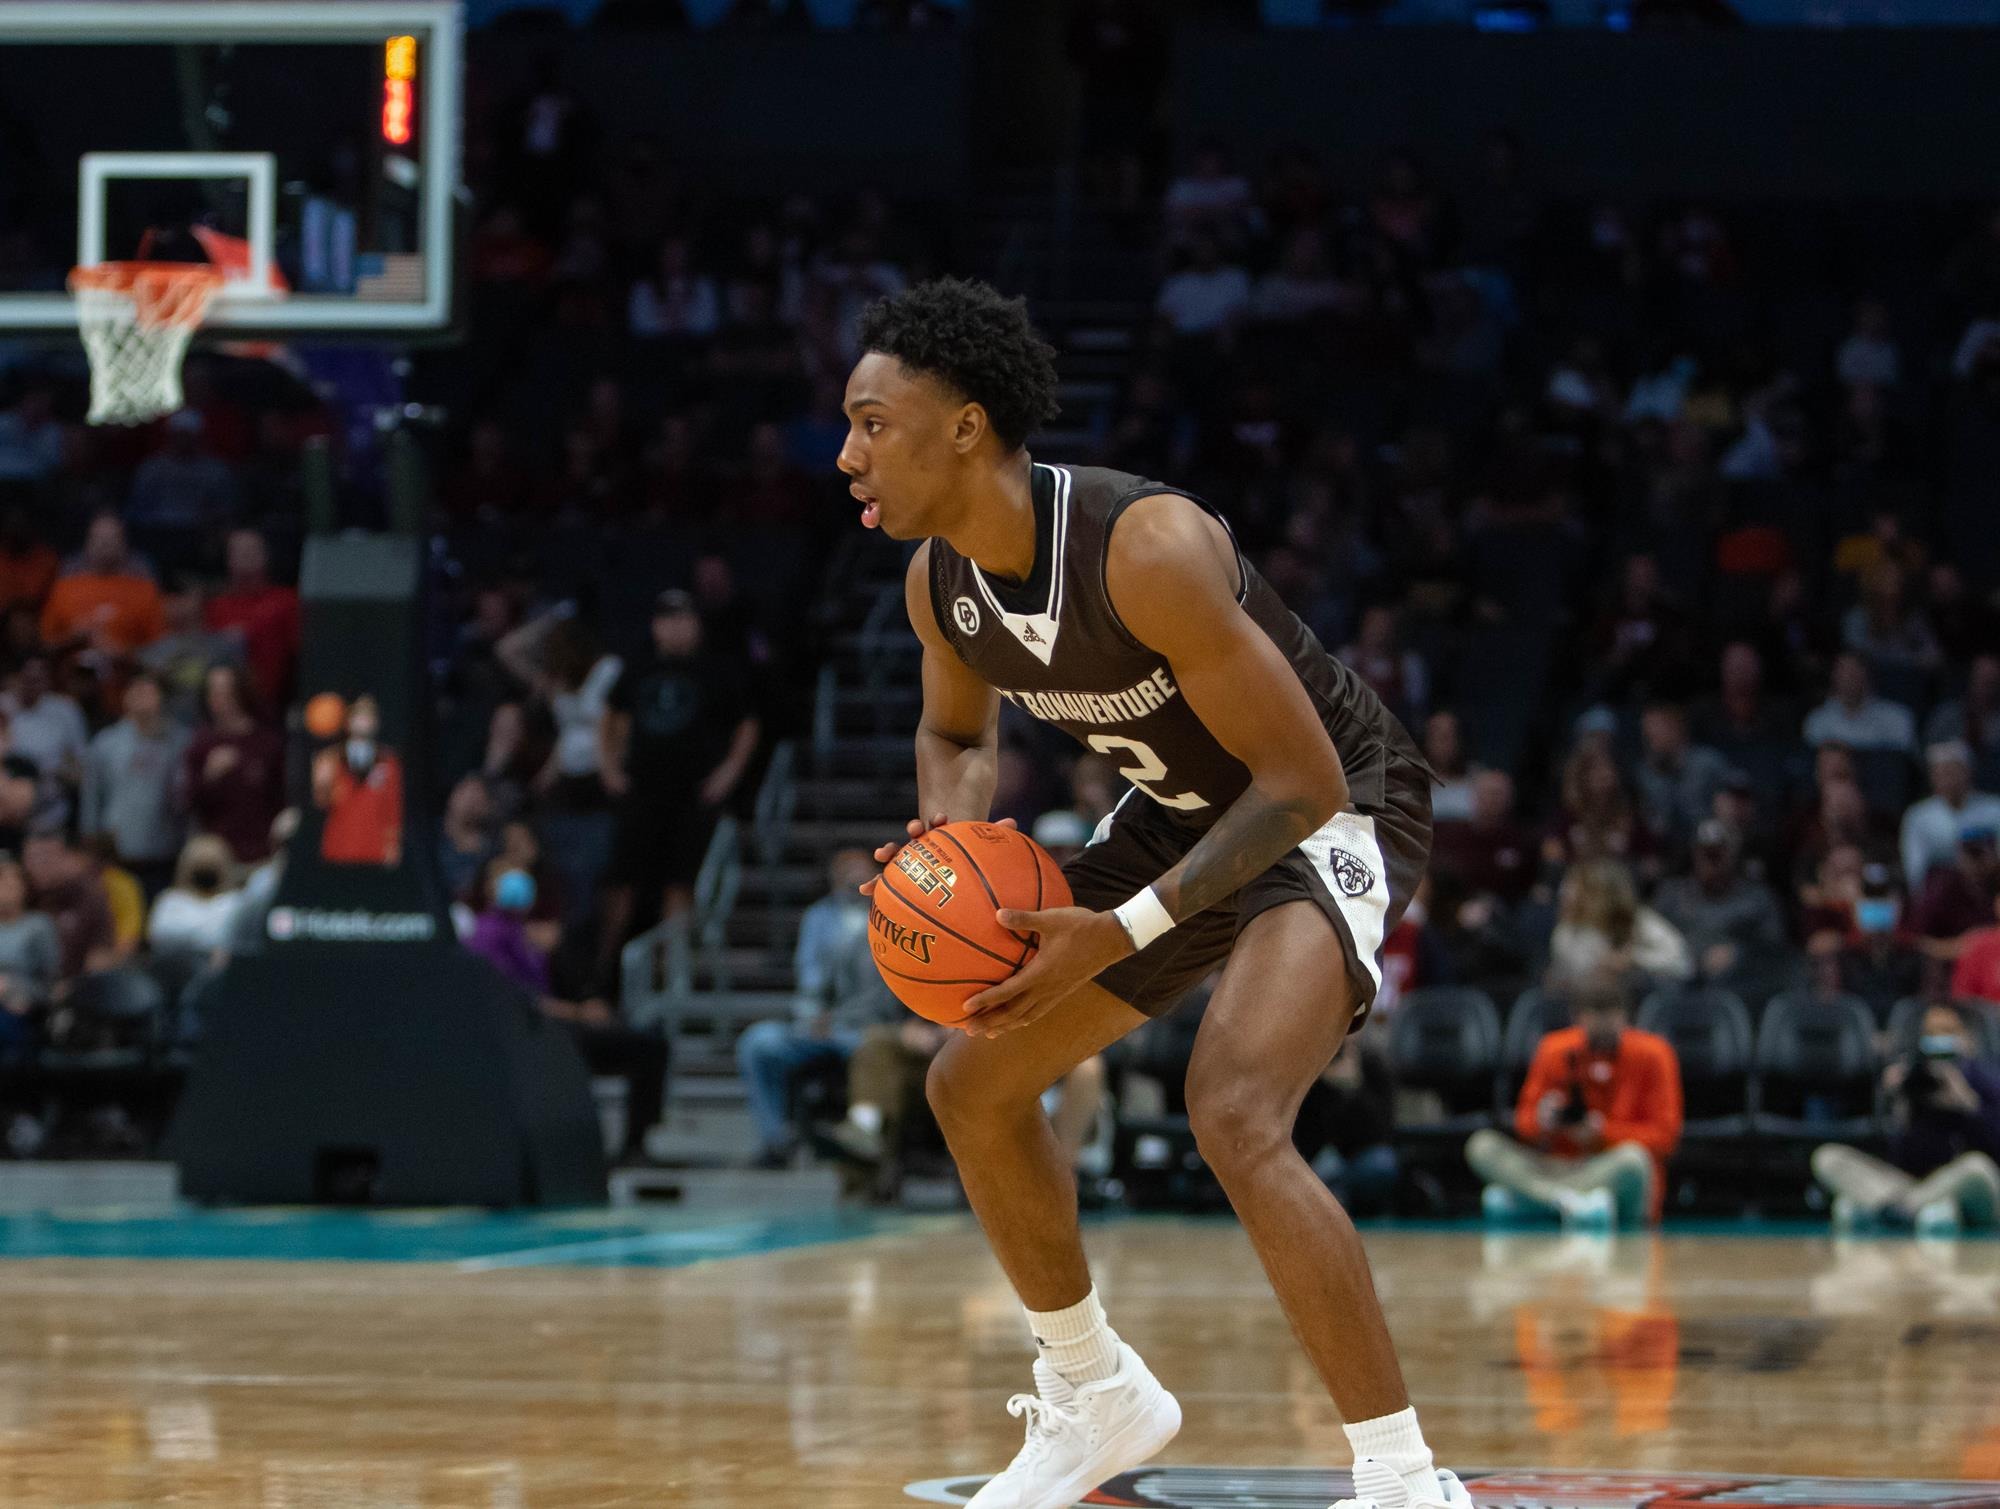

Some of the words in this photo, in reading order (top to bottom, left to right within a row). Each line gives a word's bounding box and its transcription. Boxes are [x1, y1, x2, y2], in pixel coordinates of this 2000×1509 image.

[1015, 667, 1177, 724] BONAVENTURE
[1087, 734, 1211, 811] 2
[895, 850, 954, 909] LEGA
